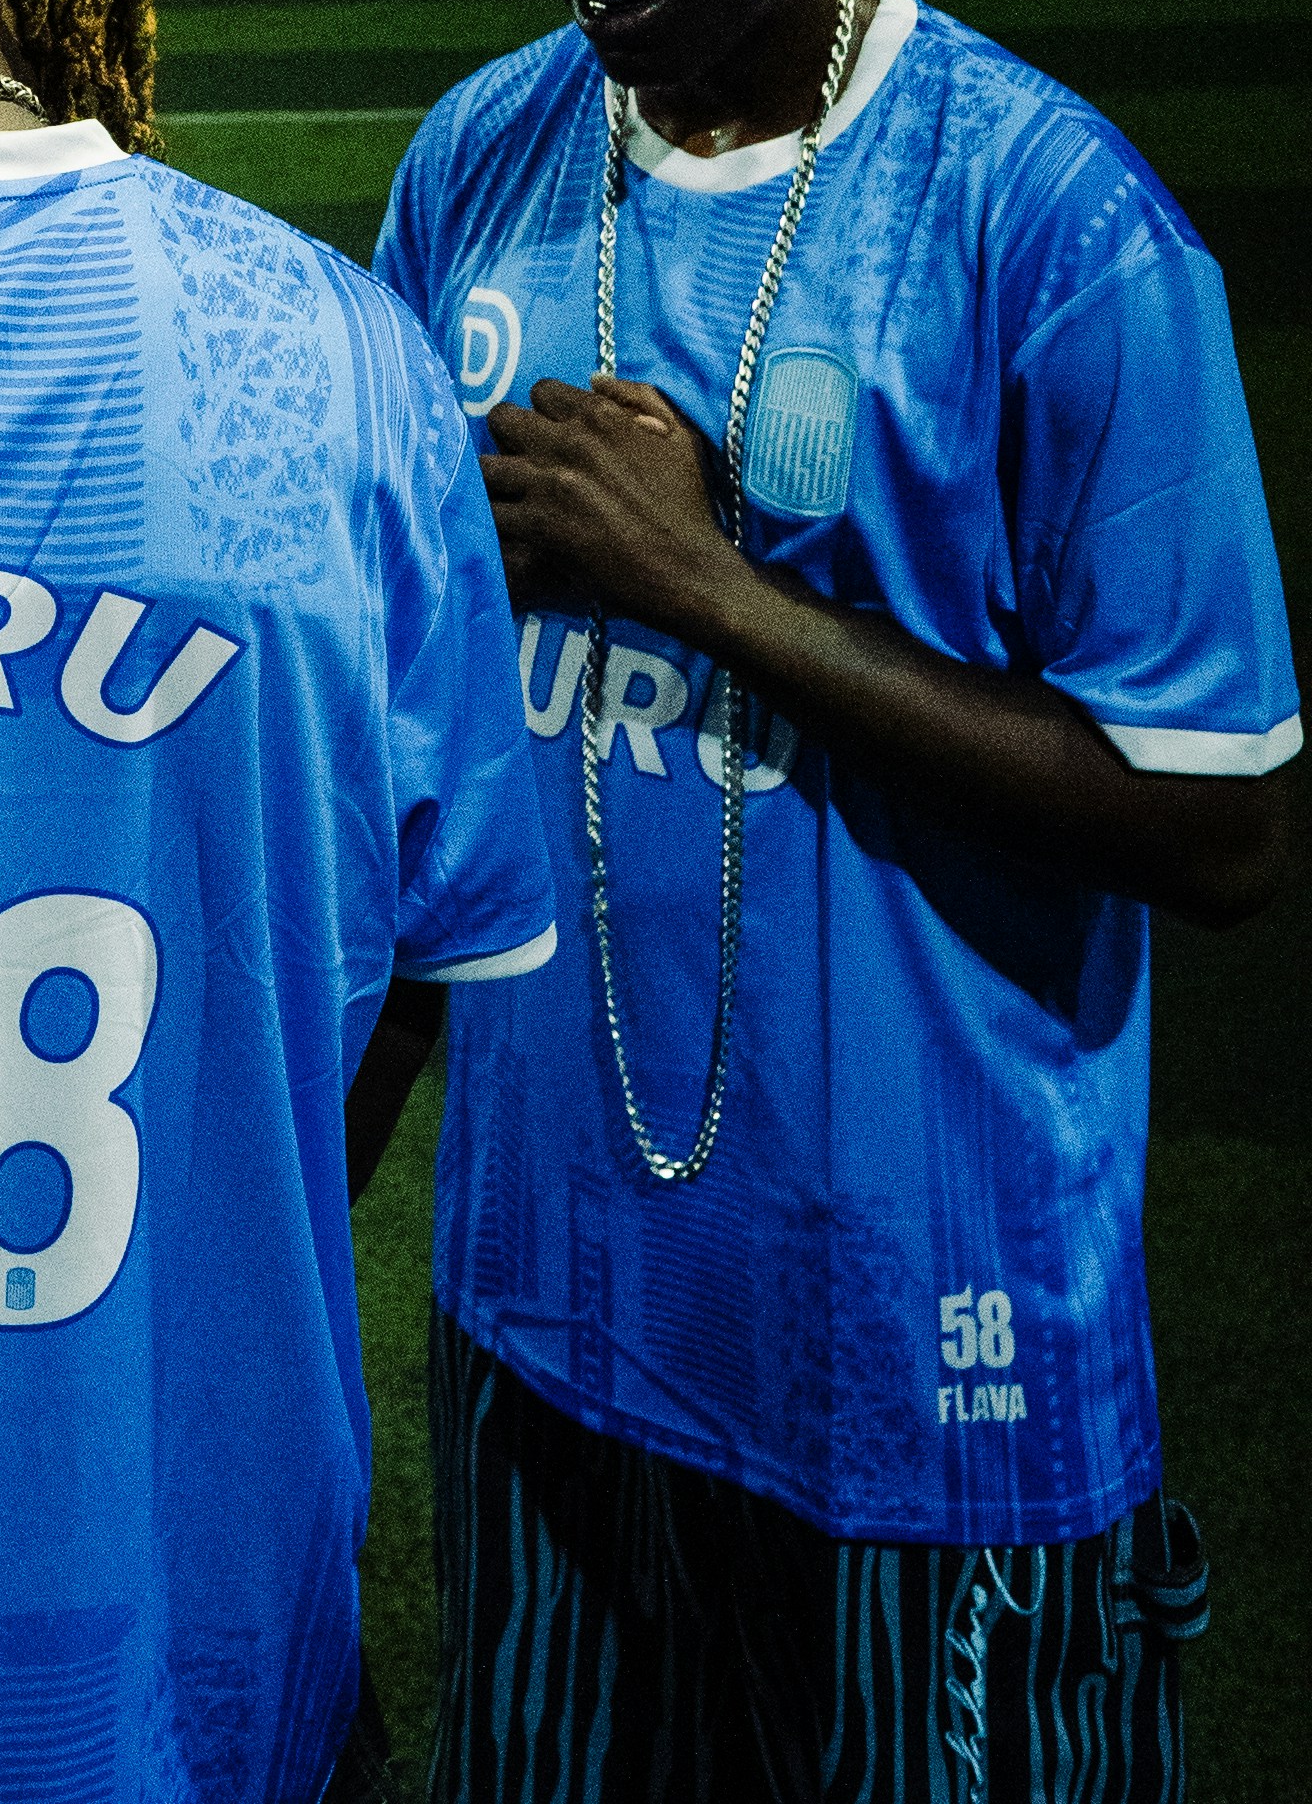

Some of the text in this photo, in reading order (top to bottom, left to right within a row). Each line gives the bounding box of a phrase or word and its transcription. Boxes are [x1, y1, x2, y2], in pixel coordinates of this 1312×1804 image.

[518, 614, 794, 793] URU
[939, 1284, 1015, 1369] 58
[937, 1384, 1027, 1425] FLAVA
